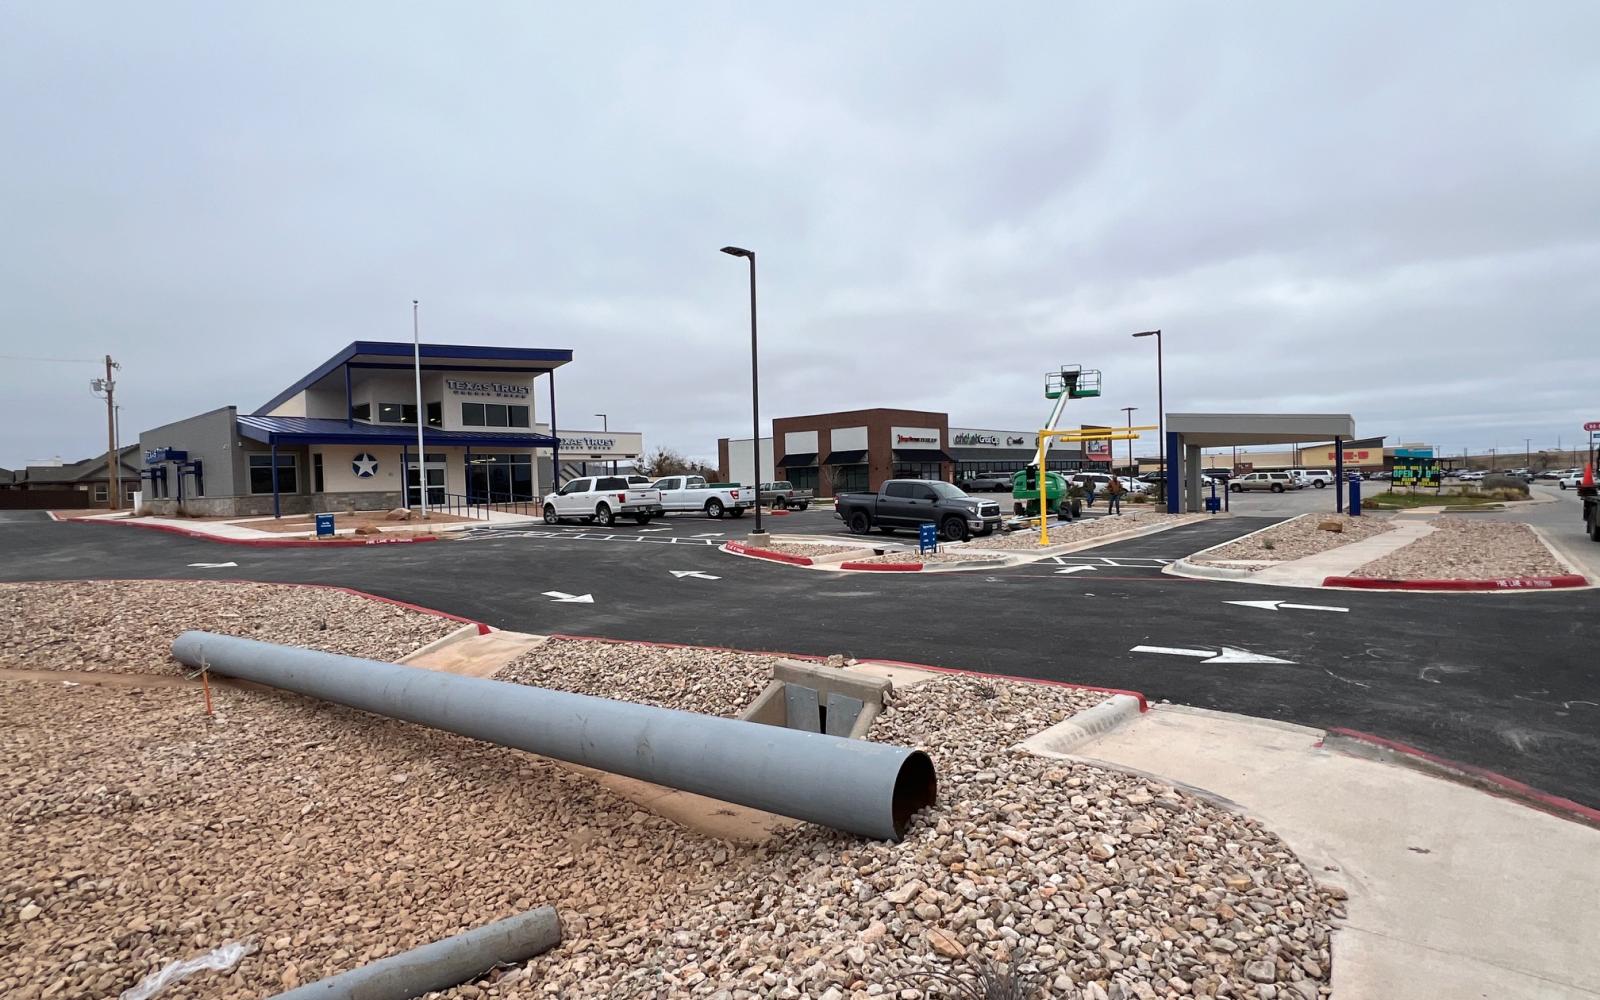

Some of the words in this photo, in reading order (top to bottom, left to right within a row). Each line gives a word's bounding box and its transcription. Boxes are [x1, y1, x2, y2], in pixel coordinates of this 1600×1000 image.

[448, 380, 490, 391] TEXAS
[492, 383, 530, 395] TRUST
[584, 438, 616, 447] TRUST
